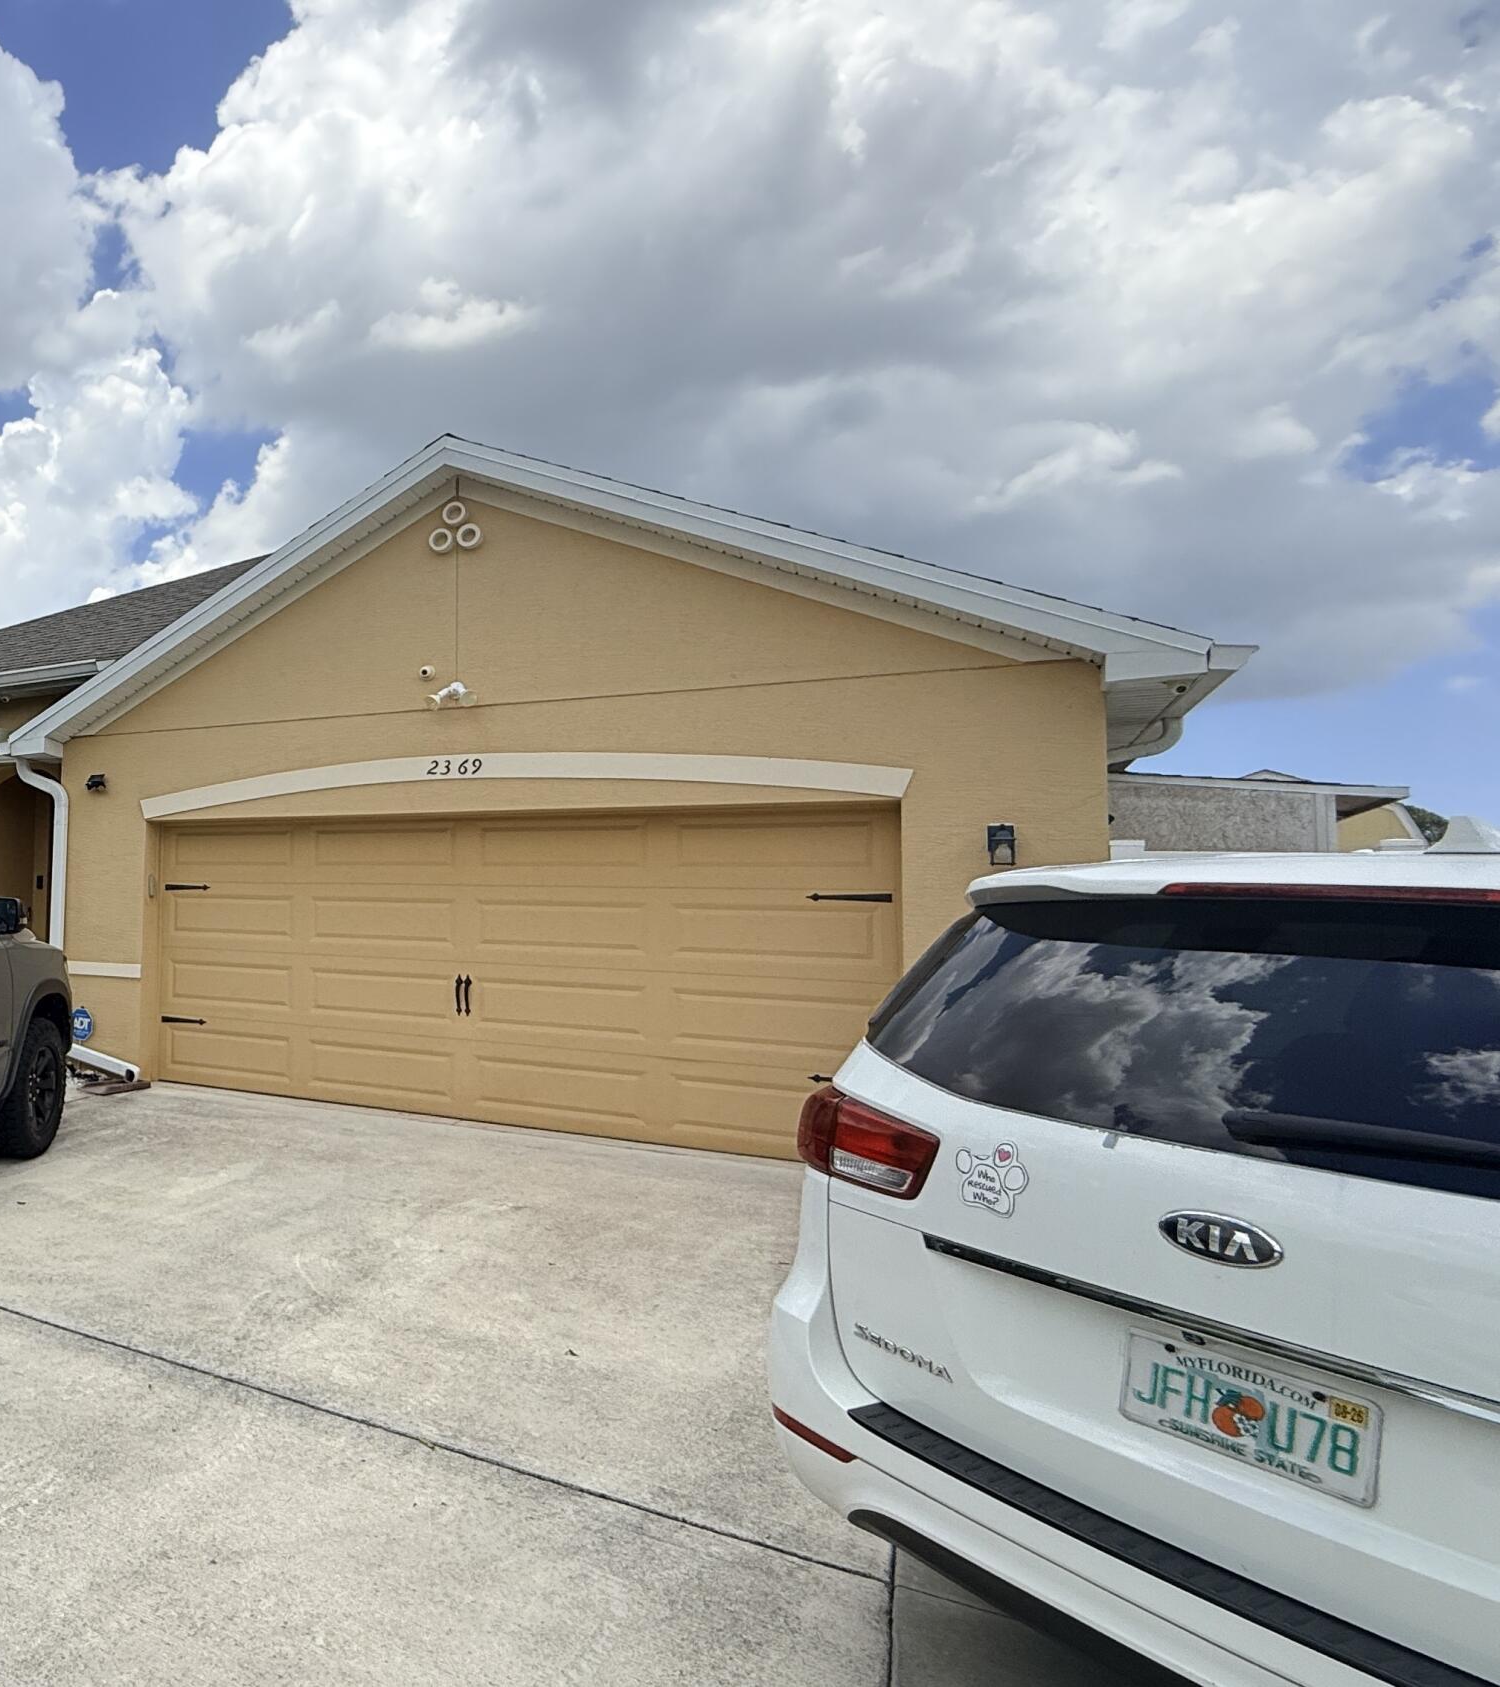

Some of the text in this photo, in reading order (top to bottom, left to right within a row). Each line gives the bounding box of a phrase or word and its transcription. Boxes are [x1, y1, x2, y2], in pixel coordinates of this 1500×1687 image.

[426, 758, 482, 775] 2369
[977, 1169, 997, 1183] Who
[1176, 1217, 1260, 1262] KIA
